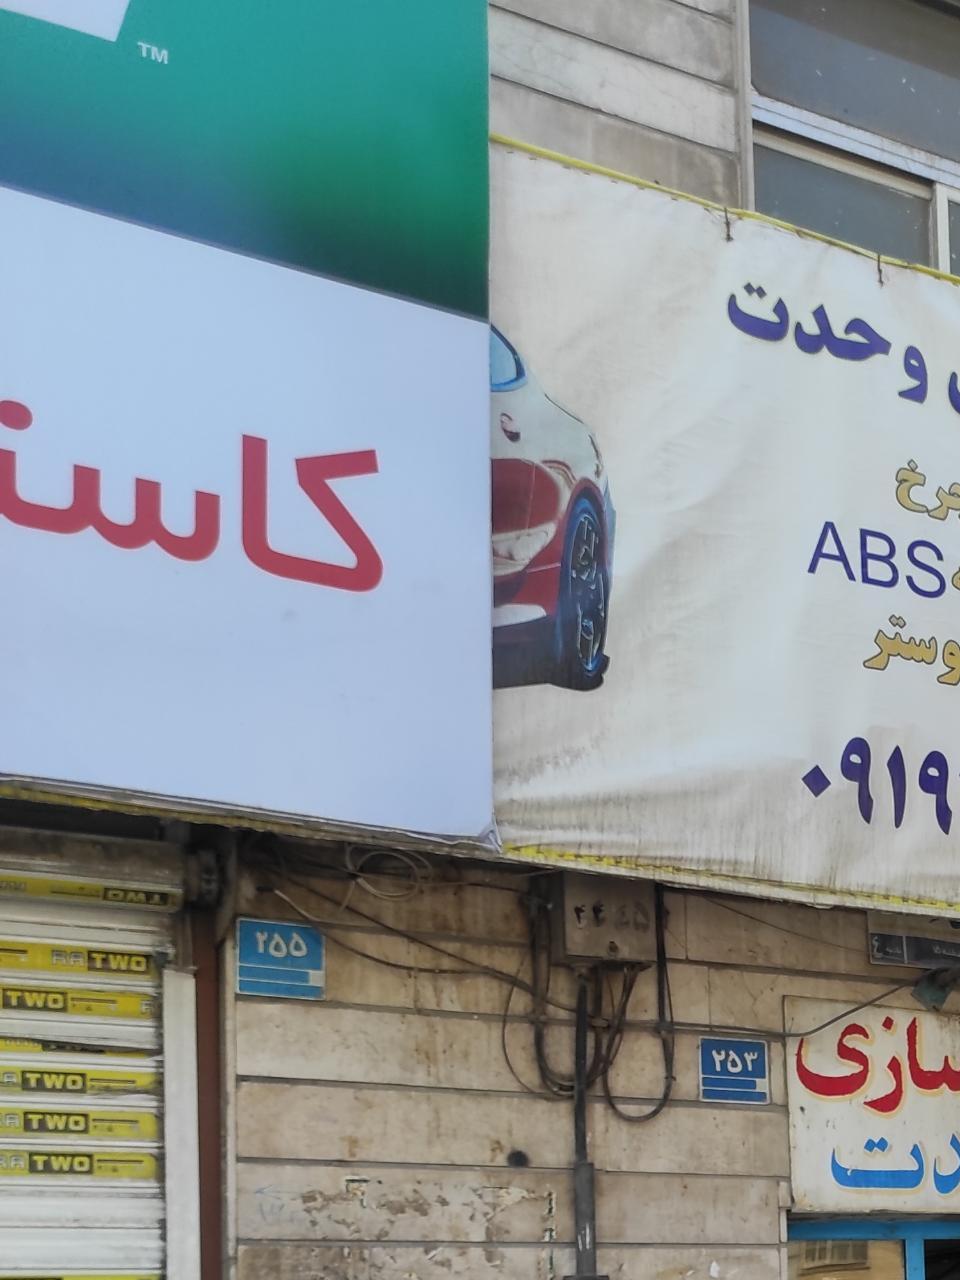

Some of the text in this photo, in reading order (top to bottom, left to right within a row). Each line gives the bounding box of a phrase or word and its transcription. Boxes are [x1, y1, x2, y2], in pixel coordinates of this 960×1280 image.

[806, 520, 948, 600] ABS
[255, 930, 308, 958] ۲۵۵
[711, 1048, 758, 1073] ۲۵۳
